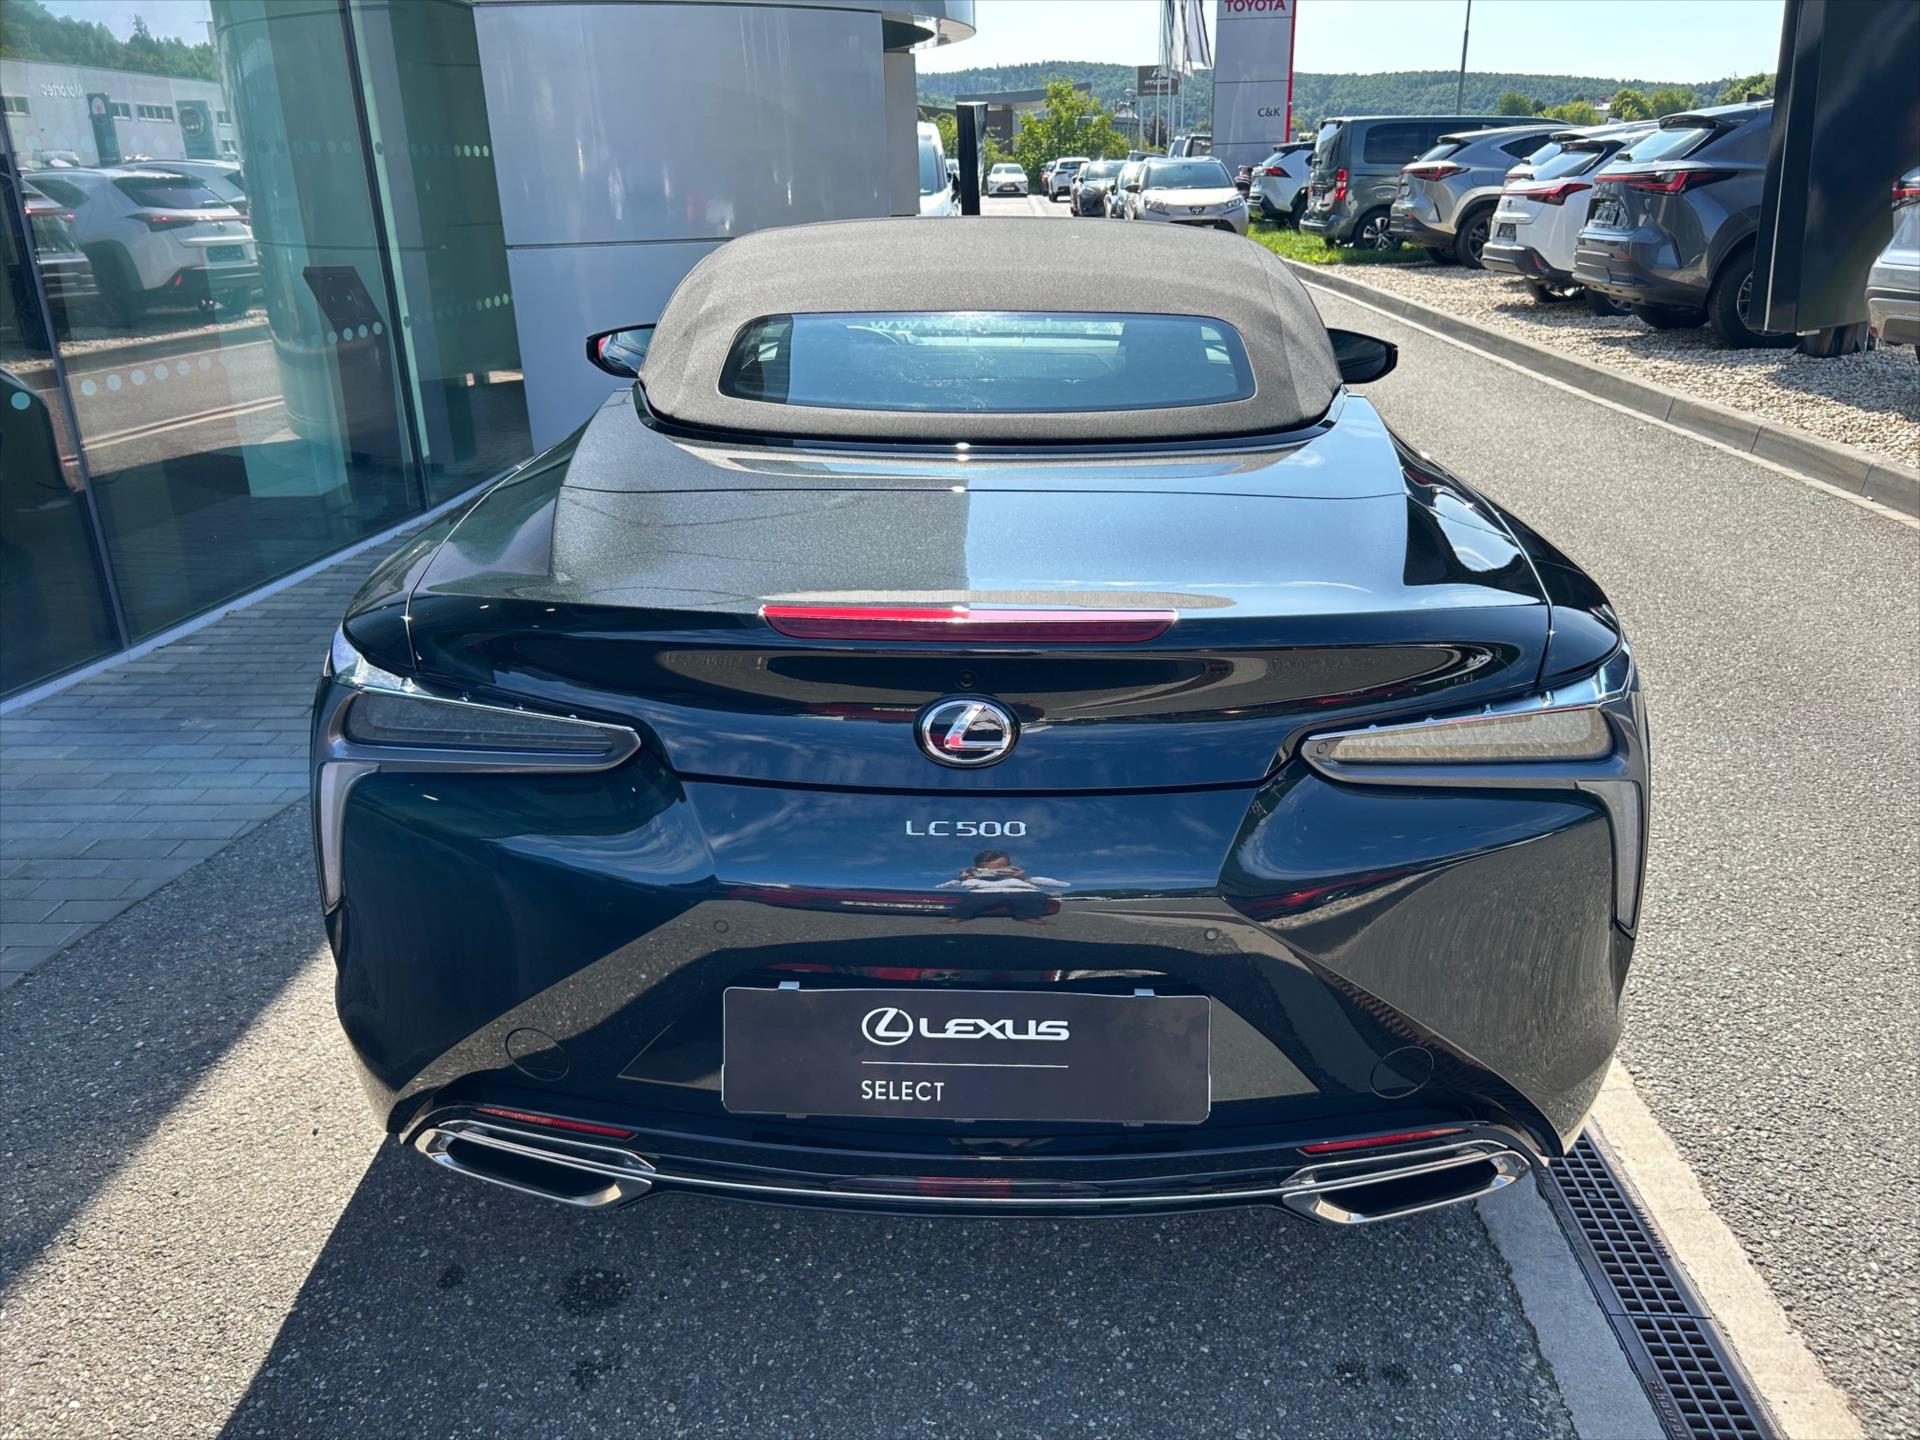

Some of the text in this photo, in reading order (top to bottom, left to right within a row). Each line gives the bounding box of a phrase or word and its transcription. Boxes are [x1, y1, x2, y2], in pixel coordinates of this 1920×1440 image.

[1224, 0, 1286, 13] TOYOTA
[1257, 106, 1281, 118] C&K
[919, 1017, 1070, 1041] LEXUS
[861, 1079, 945, 1102] SELECT
